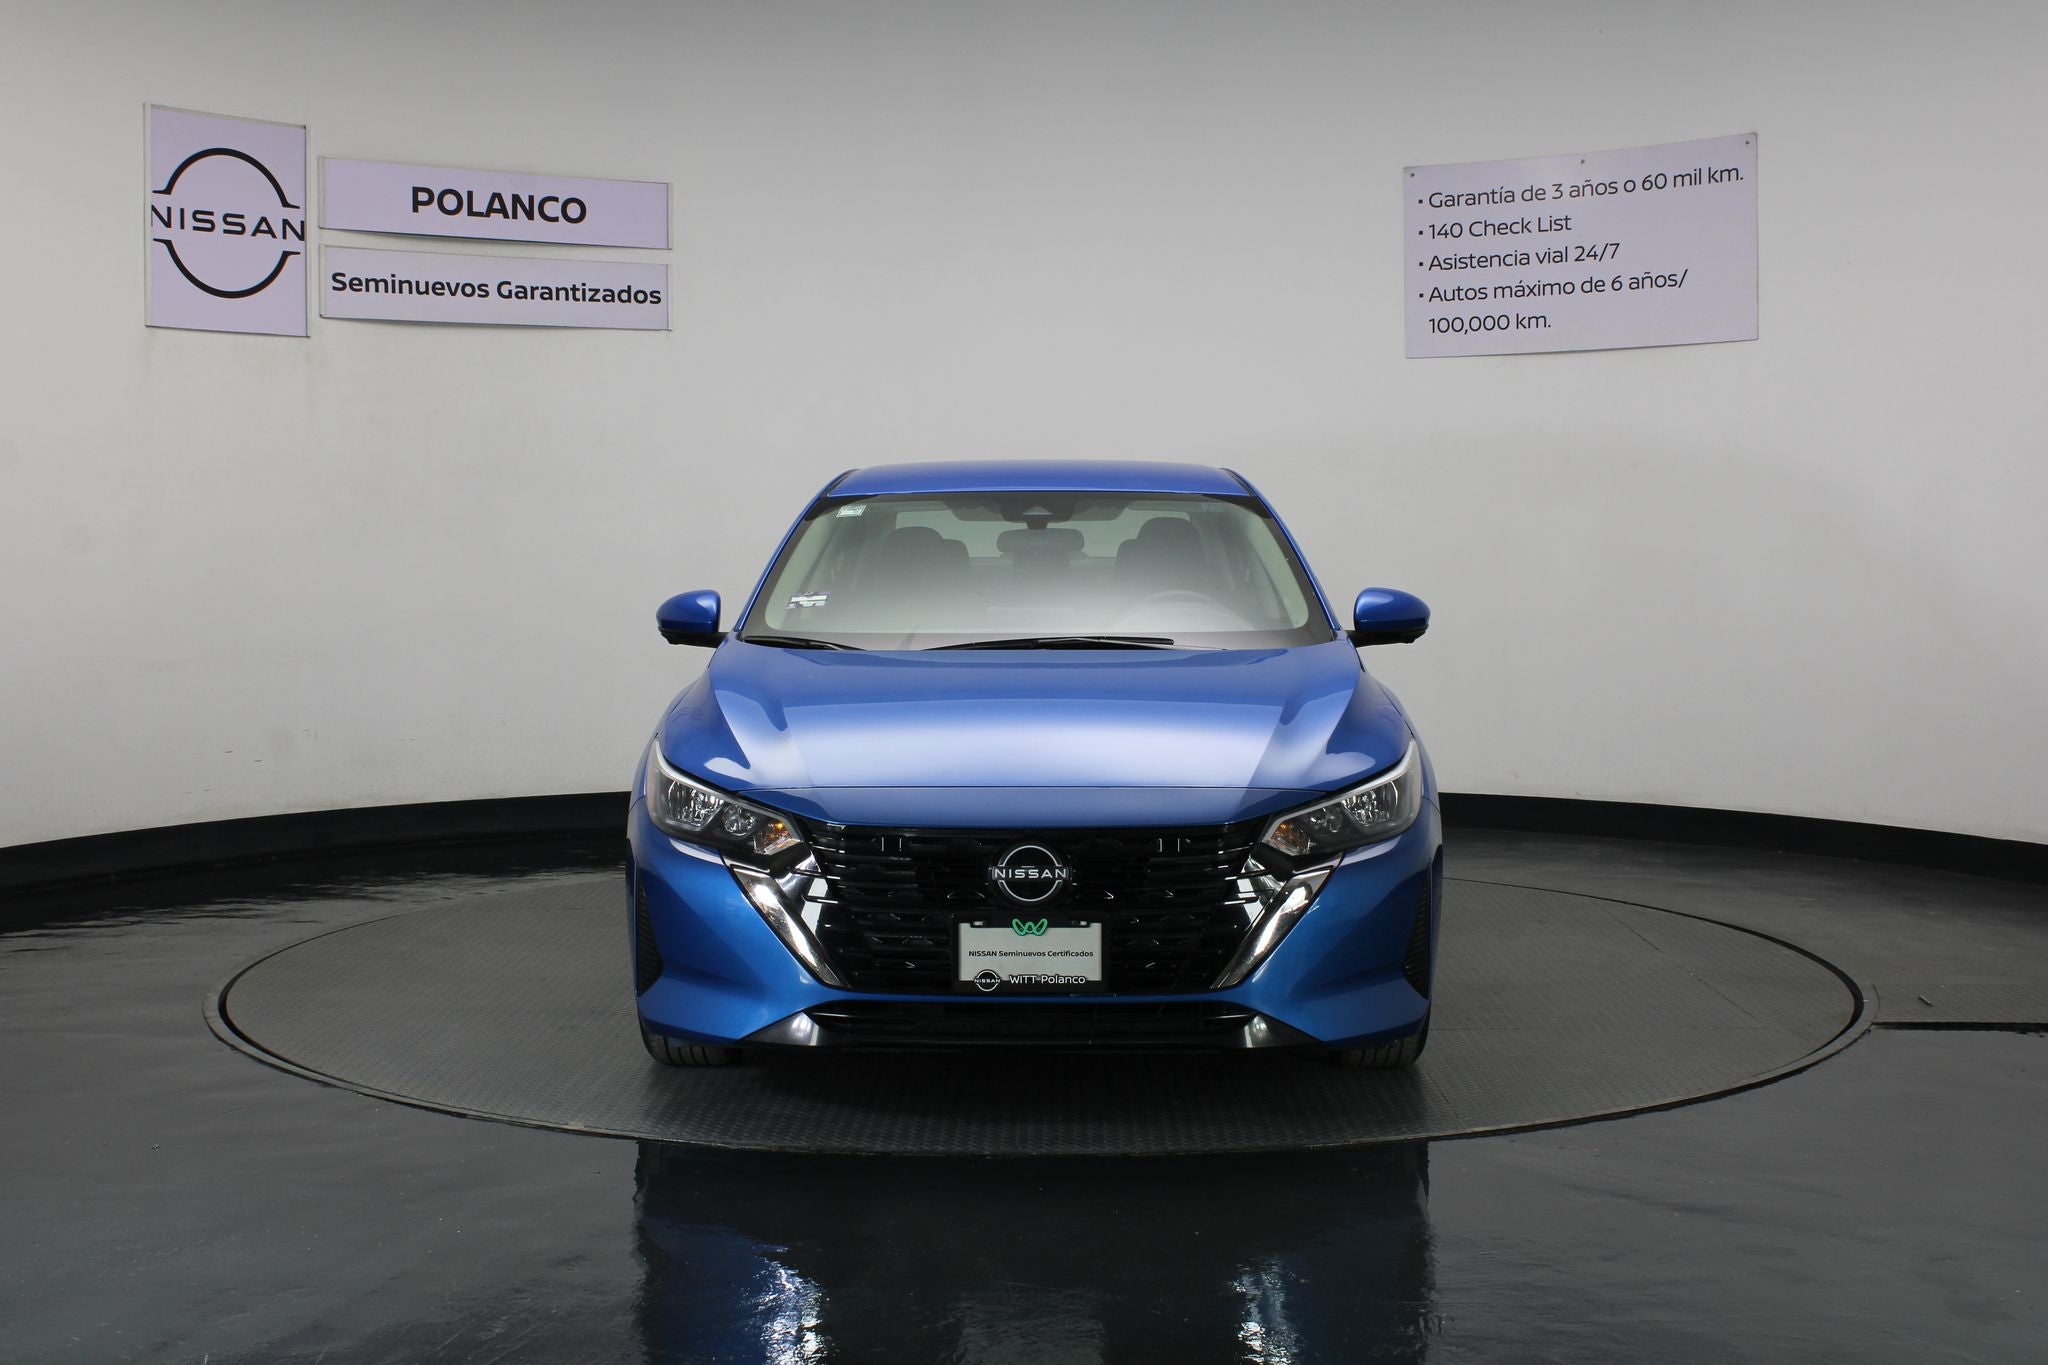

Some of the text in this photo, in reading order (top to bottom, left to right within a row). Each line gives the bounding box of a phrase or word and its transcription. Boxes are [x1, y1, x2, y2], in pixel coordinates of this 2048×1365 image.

[1428, 166, 1744, 209] Garantía de 3 años o 60 mil km.
[411, 186, 588, 224] POLANCO
[151, 204, 306, 242] NISSAN
[1428, 215, 1572, 240] 140 Check List
[1428, 242, 1621, 272] Asistencia vial 24/7
[331, 272, 662, 305] Seminuevos Garantizados
[1428, 268, 1689, 303] Autos máximo de 6 años/
[1428, 312, 1552, 335] 100,000 km.
[994, 868, 1067, 879] NISSAN
